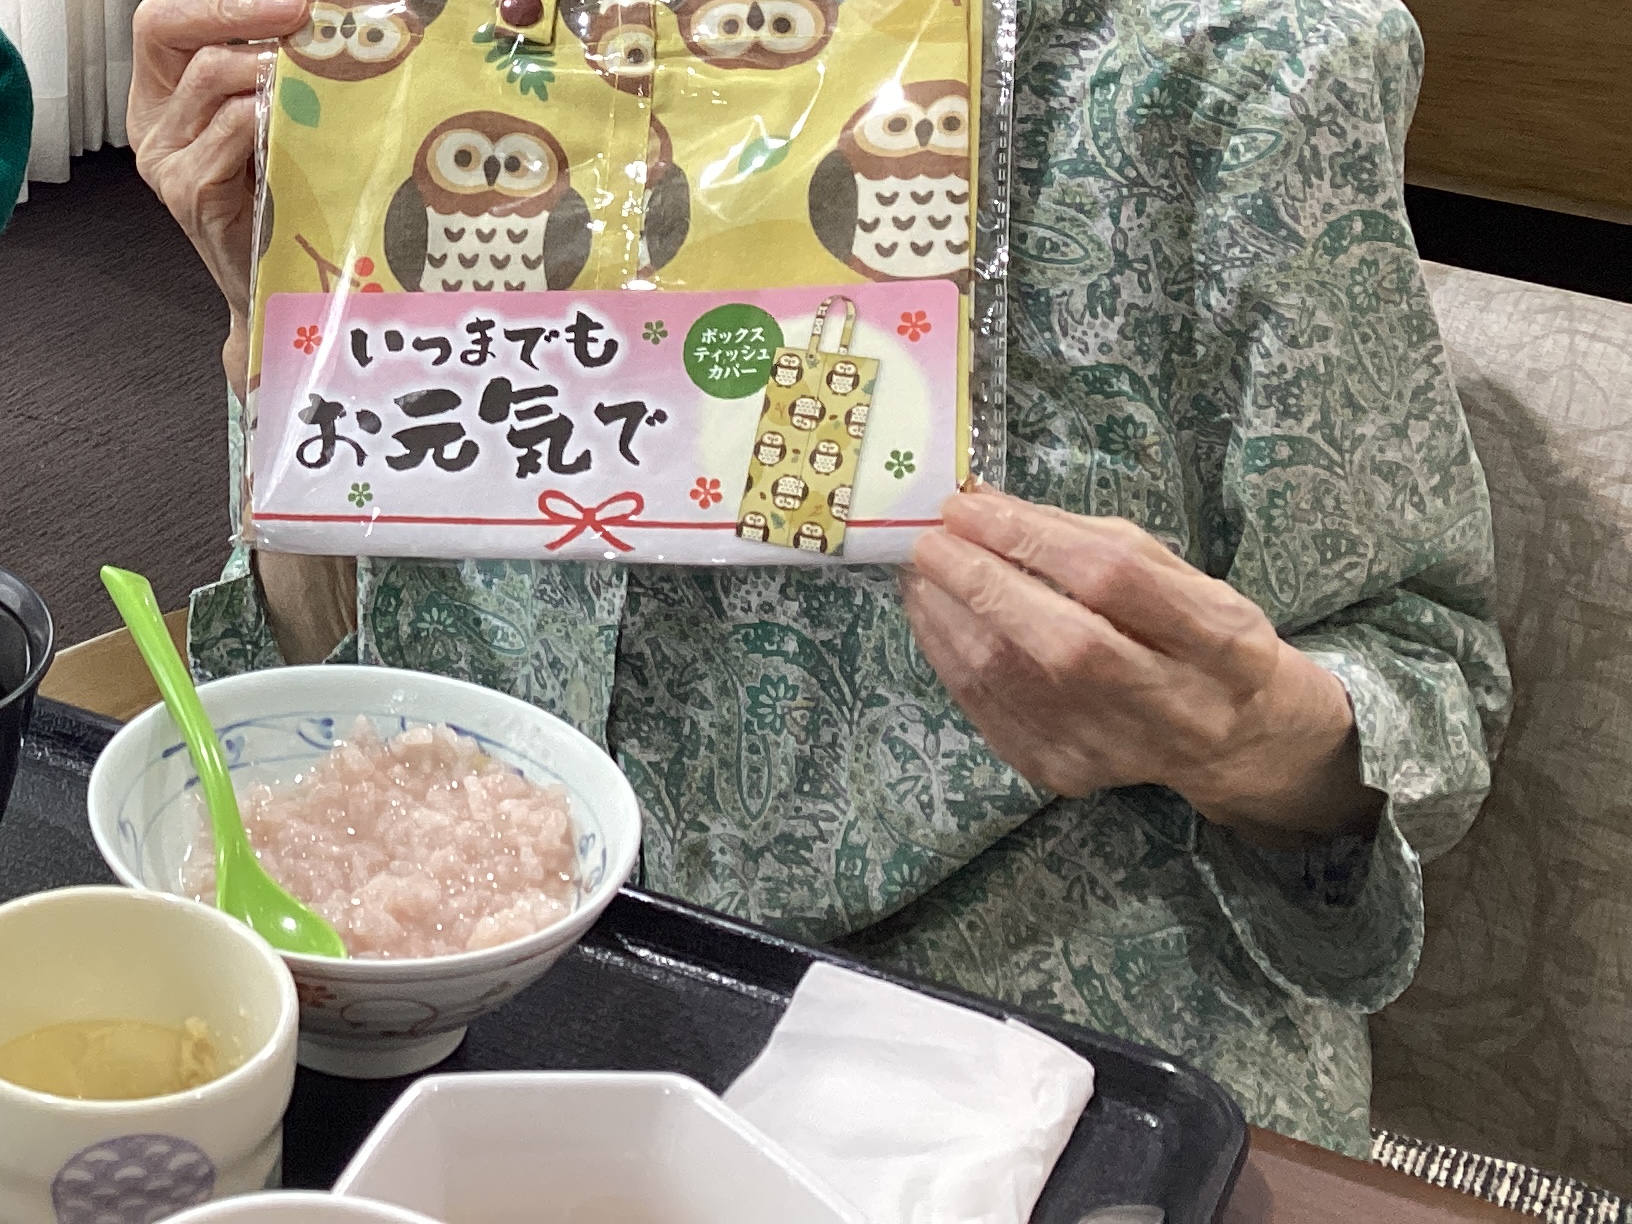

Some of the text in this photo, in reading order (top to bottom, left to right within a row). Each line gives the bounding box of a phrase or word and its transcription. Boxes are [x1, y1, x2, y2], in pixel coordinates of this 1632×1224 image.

[350, 311, 619, 369] いつまでも
[701, 326, 765, 344] ボックス
[693, 345, 771, 363] ティッシュ
[708, 364, 757, 380] カバー
[296, 377, 668, 479] お元気で
